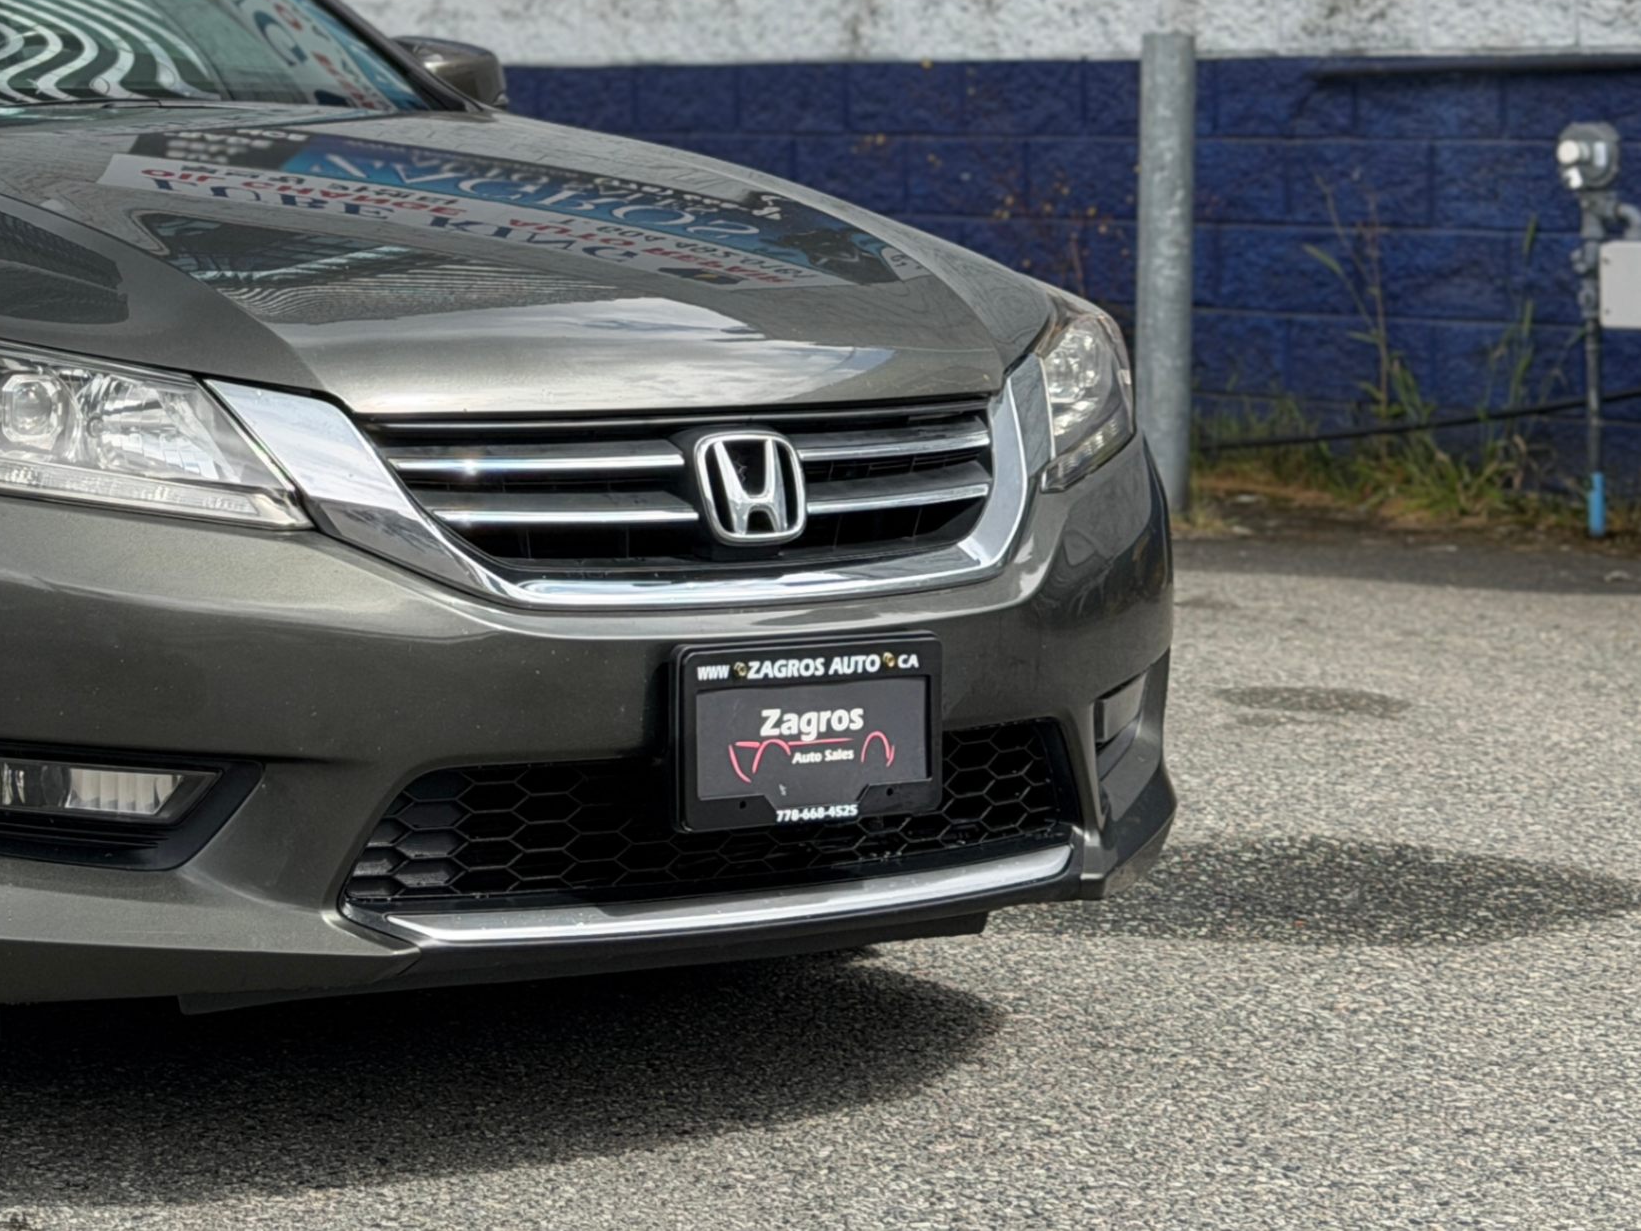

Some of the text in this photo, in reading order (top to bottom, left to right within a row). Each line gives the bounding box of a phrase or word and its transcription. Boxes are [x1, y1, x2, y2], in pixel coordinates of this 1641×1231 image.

[697, 653, 919, 681] WWW ZAGROS AUTO CA
[760, 707, 864, 743] Zagros
[791, 749, 854, 765] Auto Sales
[776, 804, 859, 822] 778-668-4525
